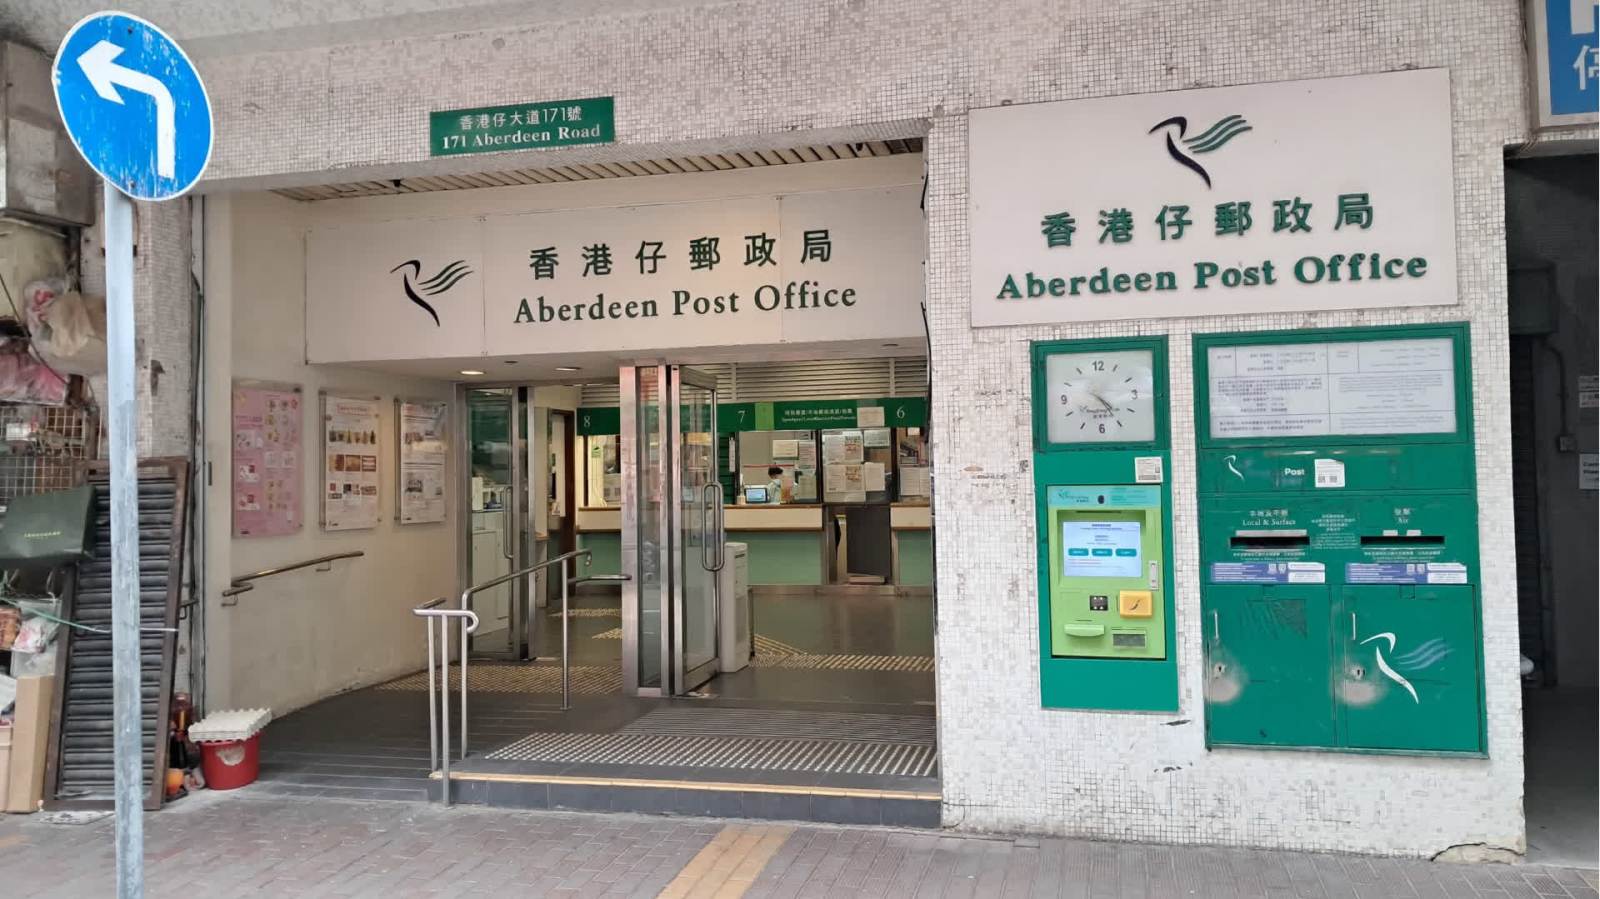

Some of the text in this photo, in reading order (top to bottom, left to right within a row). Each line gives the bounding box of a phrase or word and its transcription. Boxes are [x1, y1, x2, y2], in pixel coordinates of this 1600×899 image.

[459, 105, 583, 131] 香港仔大道171號
[442, 123, 601, 150] 171 Aberdeen Road
[1040, 192, 1374, 249] 香港仔郵政局
[529, 228, 833, 281] 香港仔郵政局
[995, 252, 1428, 300] Aberdeen Post Office
[513, 279, 857, 324] Aberdeen Post Office
[1092, 360, 1105, 372] 12
[1060, 394, 1068, 405] 9
[1131, 389, 1138, 400] 3
[737, 409, 746, 425] 7
[896, 405, 906, 419] 6
[583, 414, 591, 428] 8
[1098, 423, 1106, 434] 6
[1284, 467, 1305, 476] Post
